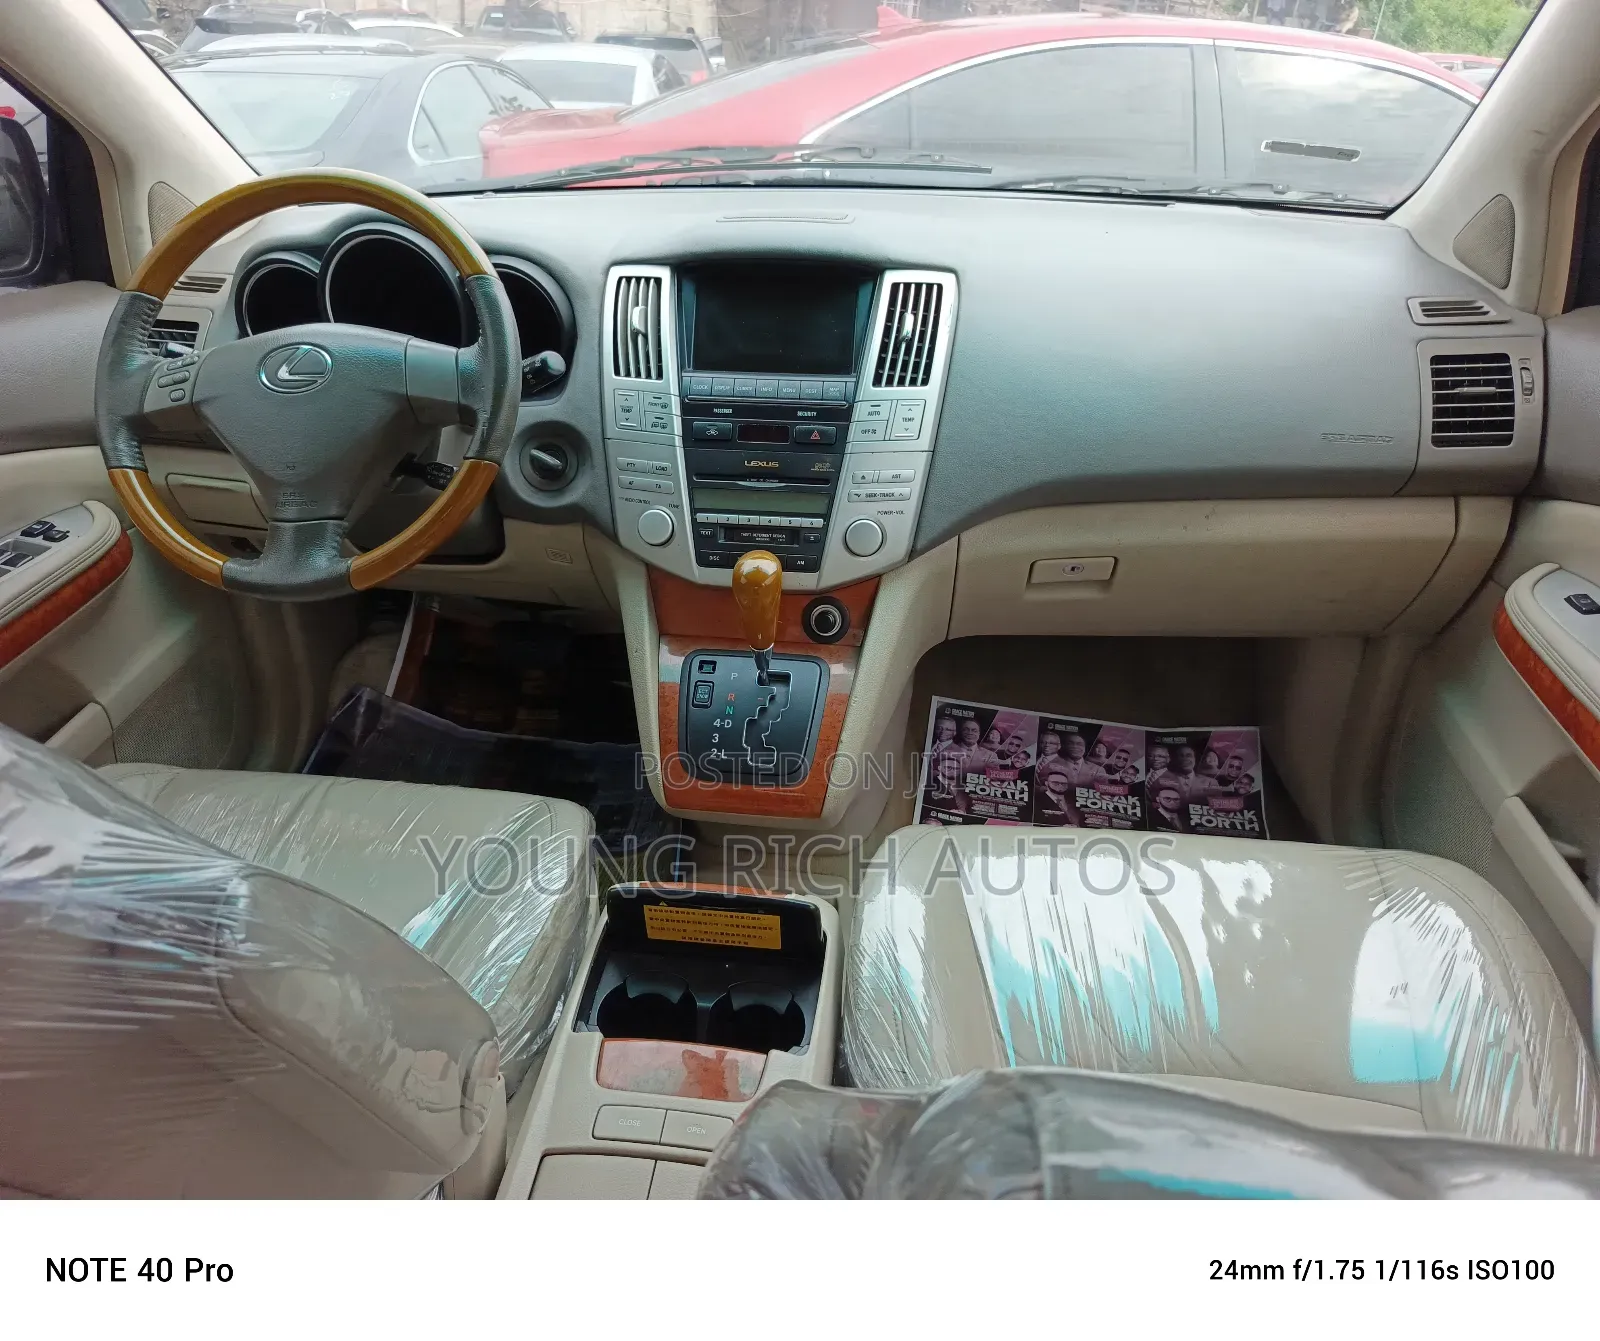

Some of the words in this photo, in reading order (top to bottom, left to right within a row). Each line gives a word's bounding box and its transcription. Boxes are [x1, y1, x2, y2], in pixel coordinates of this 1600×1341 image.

[744, 460, 779, 468] LEXUS
[731, 672, 738, 680] P
[728, 693, 735, 701] R
[725, 706, 734, 715] N
[713, 718, 732, 728] 4-D
[711, 733, 719, 743] 3
[710, 748, 728, 759] 2-L
[964, 783, 1029, 802] FORTH
[1075, 797, 1142, 818] FORTH
[1189, 814, 1260, 832] FORTH
[618, 1118, 641, 1127] CLOSE
[686, 1126, 707, 1135] OPEN
